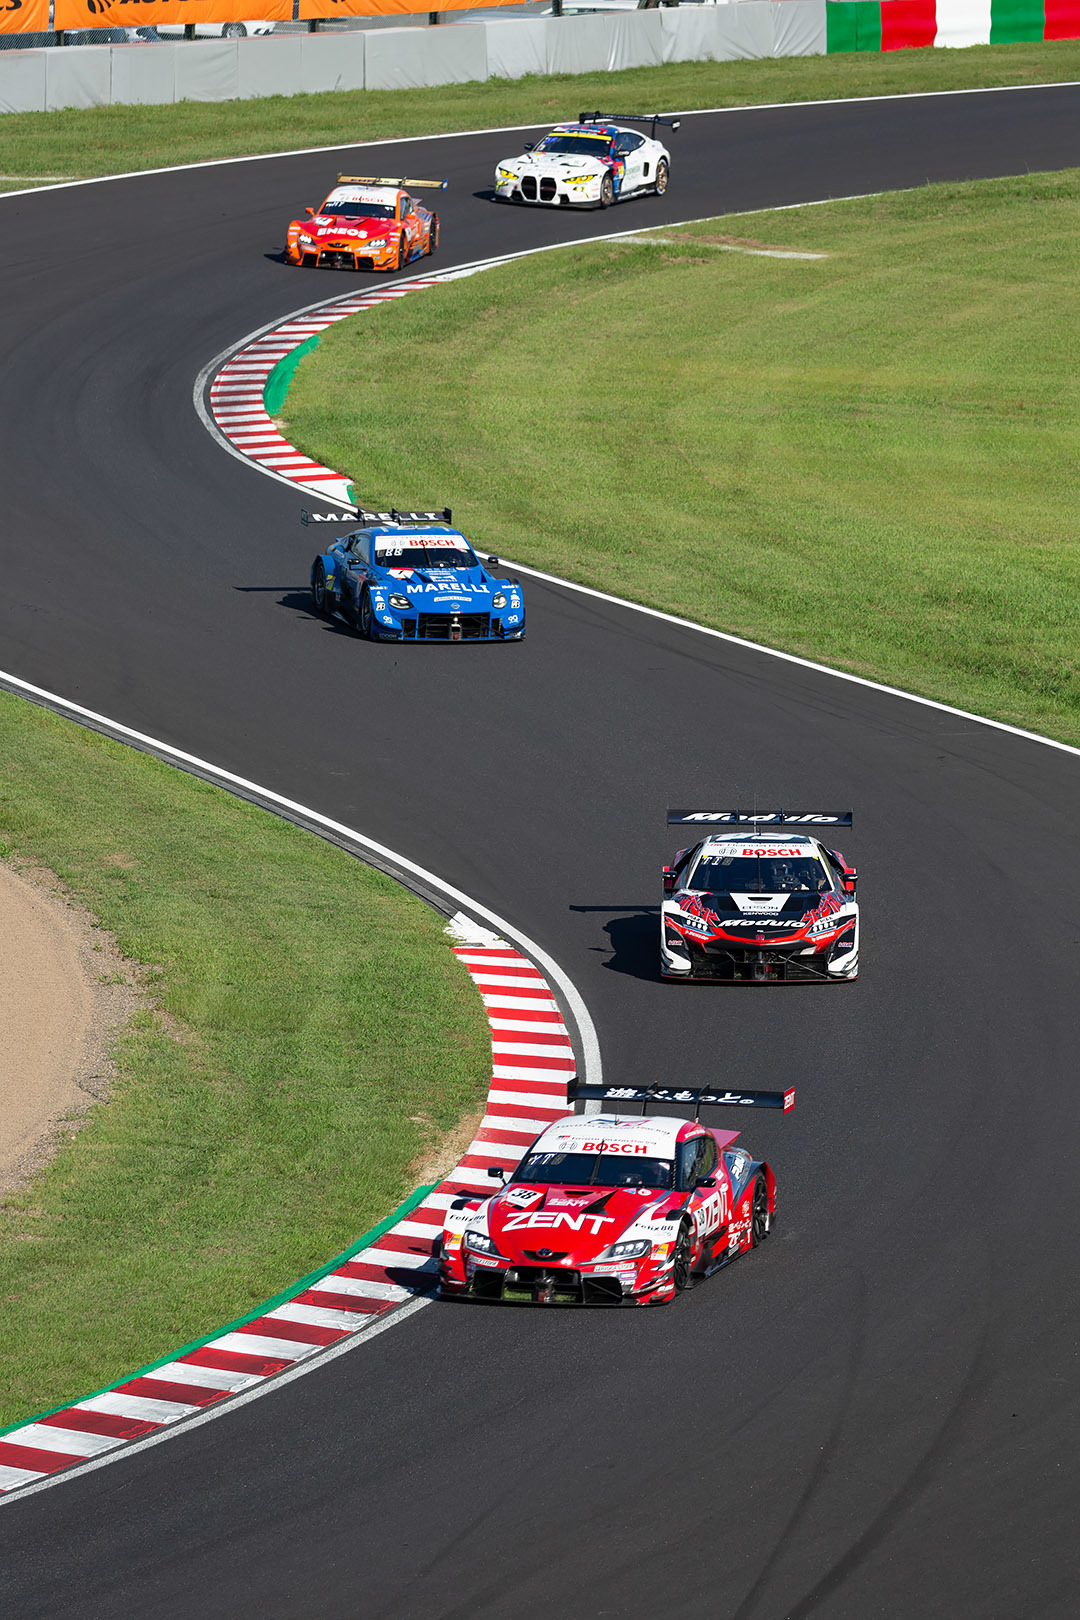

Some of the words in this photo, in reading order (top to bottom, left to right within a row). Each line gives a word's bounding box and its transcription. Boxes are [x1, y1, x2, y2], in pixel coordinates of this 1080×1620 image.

[317, 228, 368, 239] ENEOS
[312, 512, 440, 522] MARELLI
[409, 539, 456, 547] BOSCH
[406, 582, 491, 594] MARELLI
[682, 812, 839, 823] Modulo
[742, 848, 802, 857] BOSCH
[717, 919, 806, 928] Modulo
[582, 1142, 647, 1154] BOSCH
[512, 1189, 537, 1200] 38
[501, 1212, 616, 1236] ZENT
